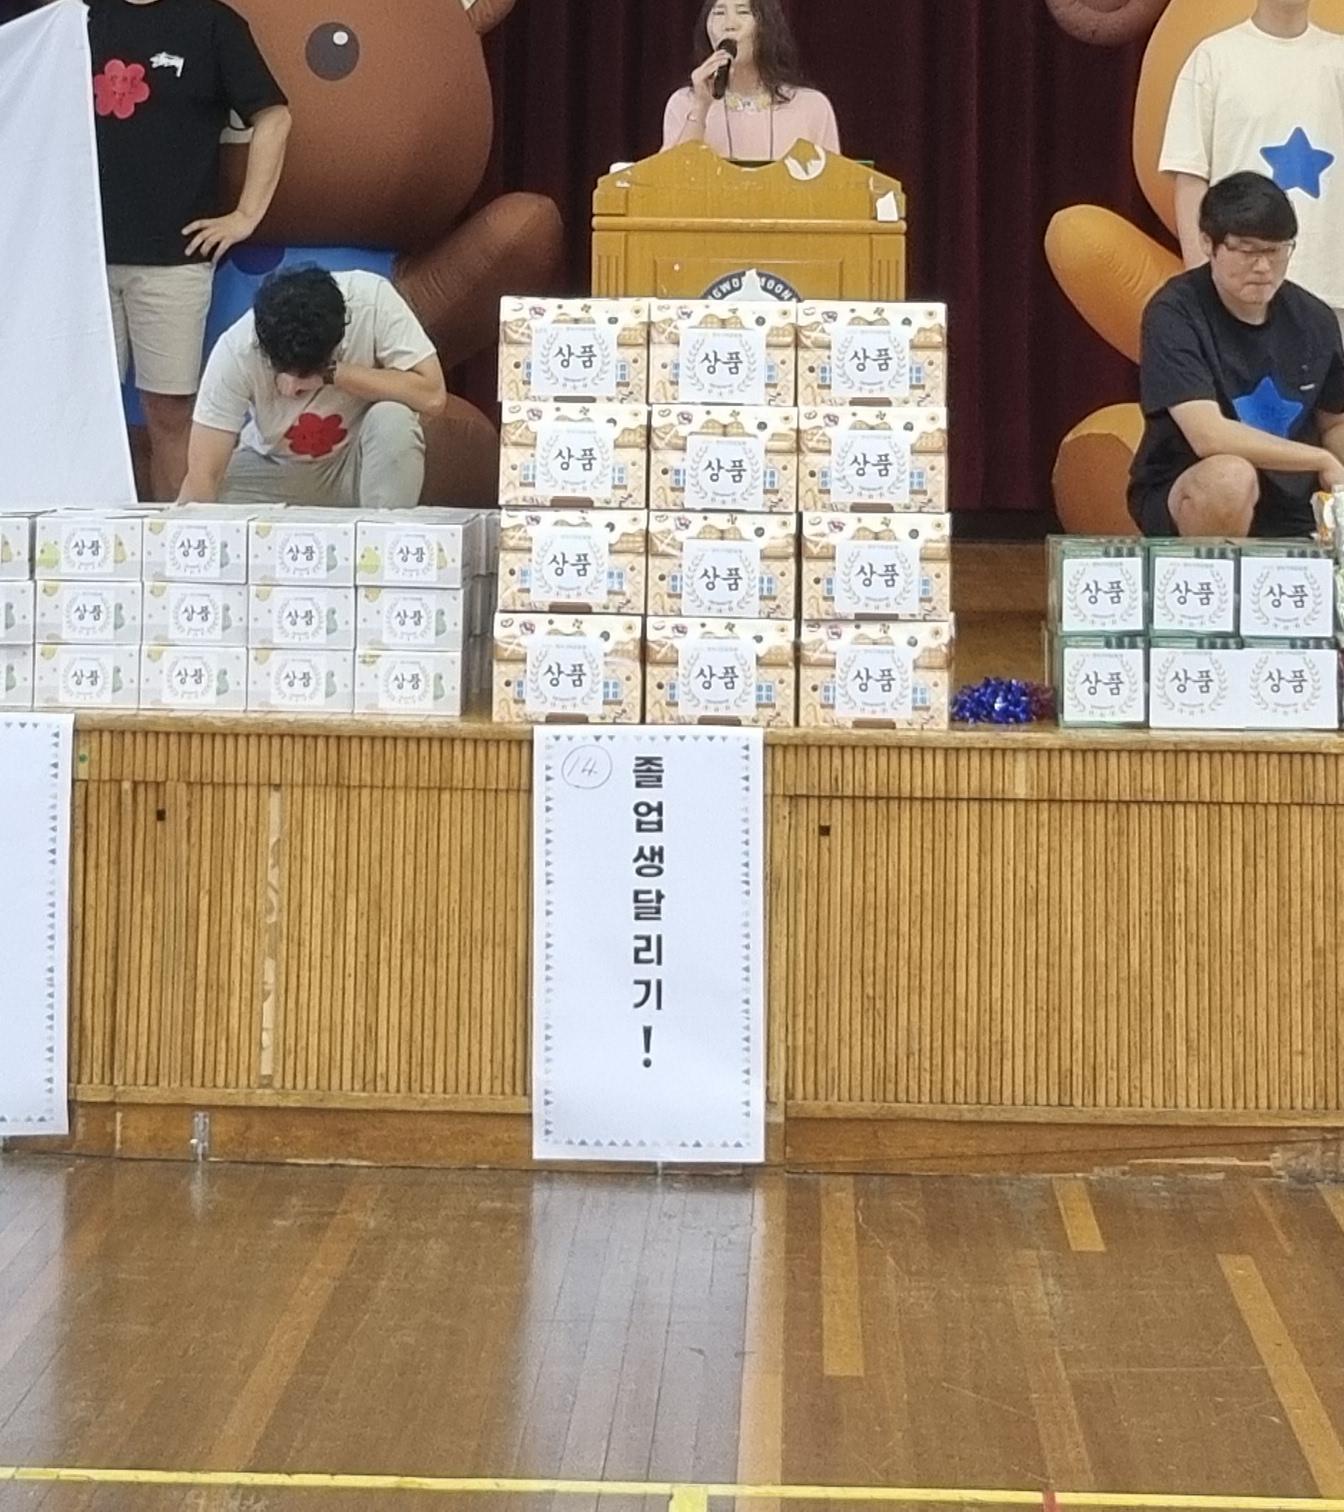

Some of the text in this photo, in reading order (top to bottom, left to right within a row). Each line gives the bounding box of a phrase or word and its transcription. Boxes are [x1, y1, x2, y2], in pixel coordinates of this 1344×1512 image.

[555, 344, 597, 369] 상품
[701, 350, 743, 375] 상품
[850, 348, 892, 372] 상품
[555, 447, 597, 471] 상품
[704, 458, 747, 483] 상품
[850, 453, 892, 477] 상품
[549, 552, 591, 577] 상품
[856, 563, 899, 587] 상품
[700, 566, 743, 591] 상품
[1082, 580, 1124, 604] 상품
[1171, 581, 1214, 605] 상품
[1266, 584, 1308, 608] 상품
[544, 662, 586, 687] 상품
[696, 665, 739, 690] 상품
[853, 668, 895, 692] 상품
[1082, 671, 1124, 695] 상품
[1170, 669, 1213, 693] 상품
[1265, 669, 1307, 693] 상품
